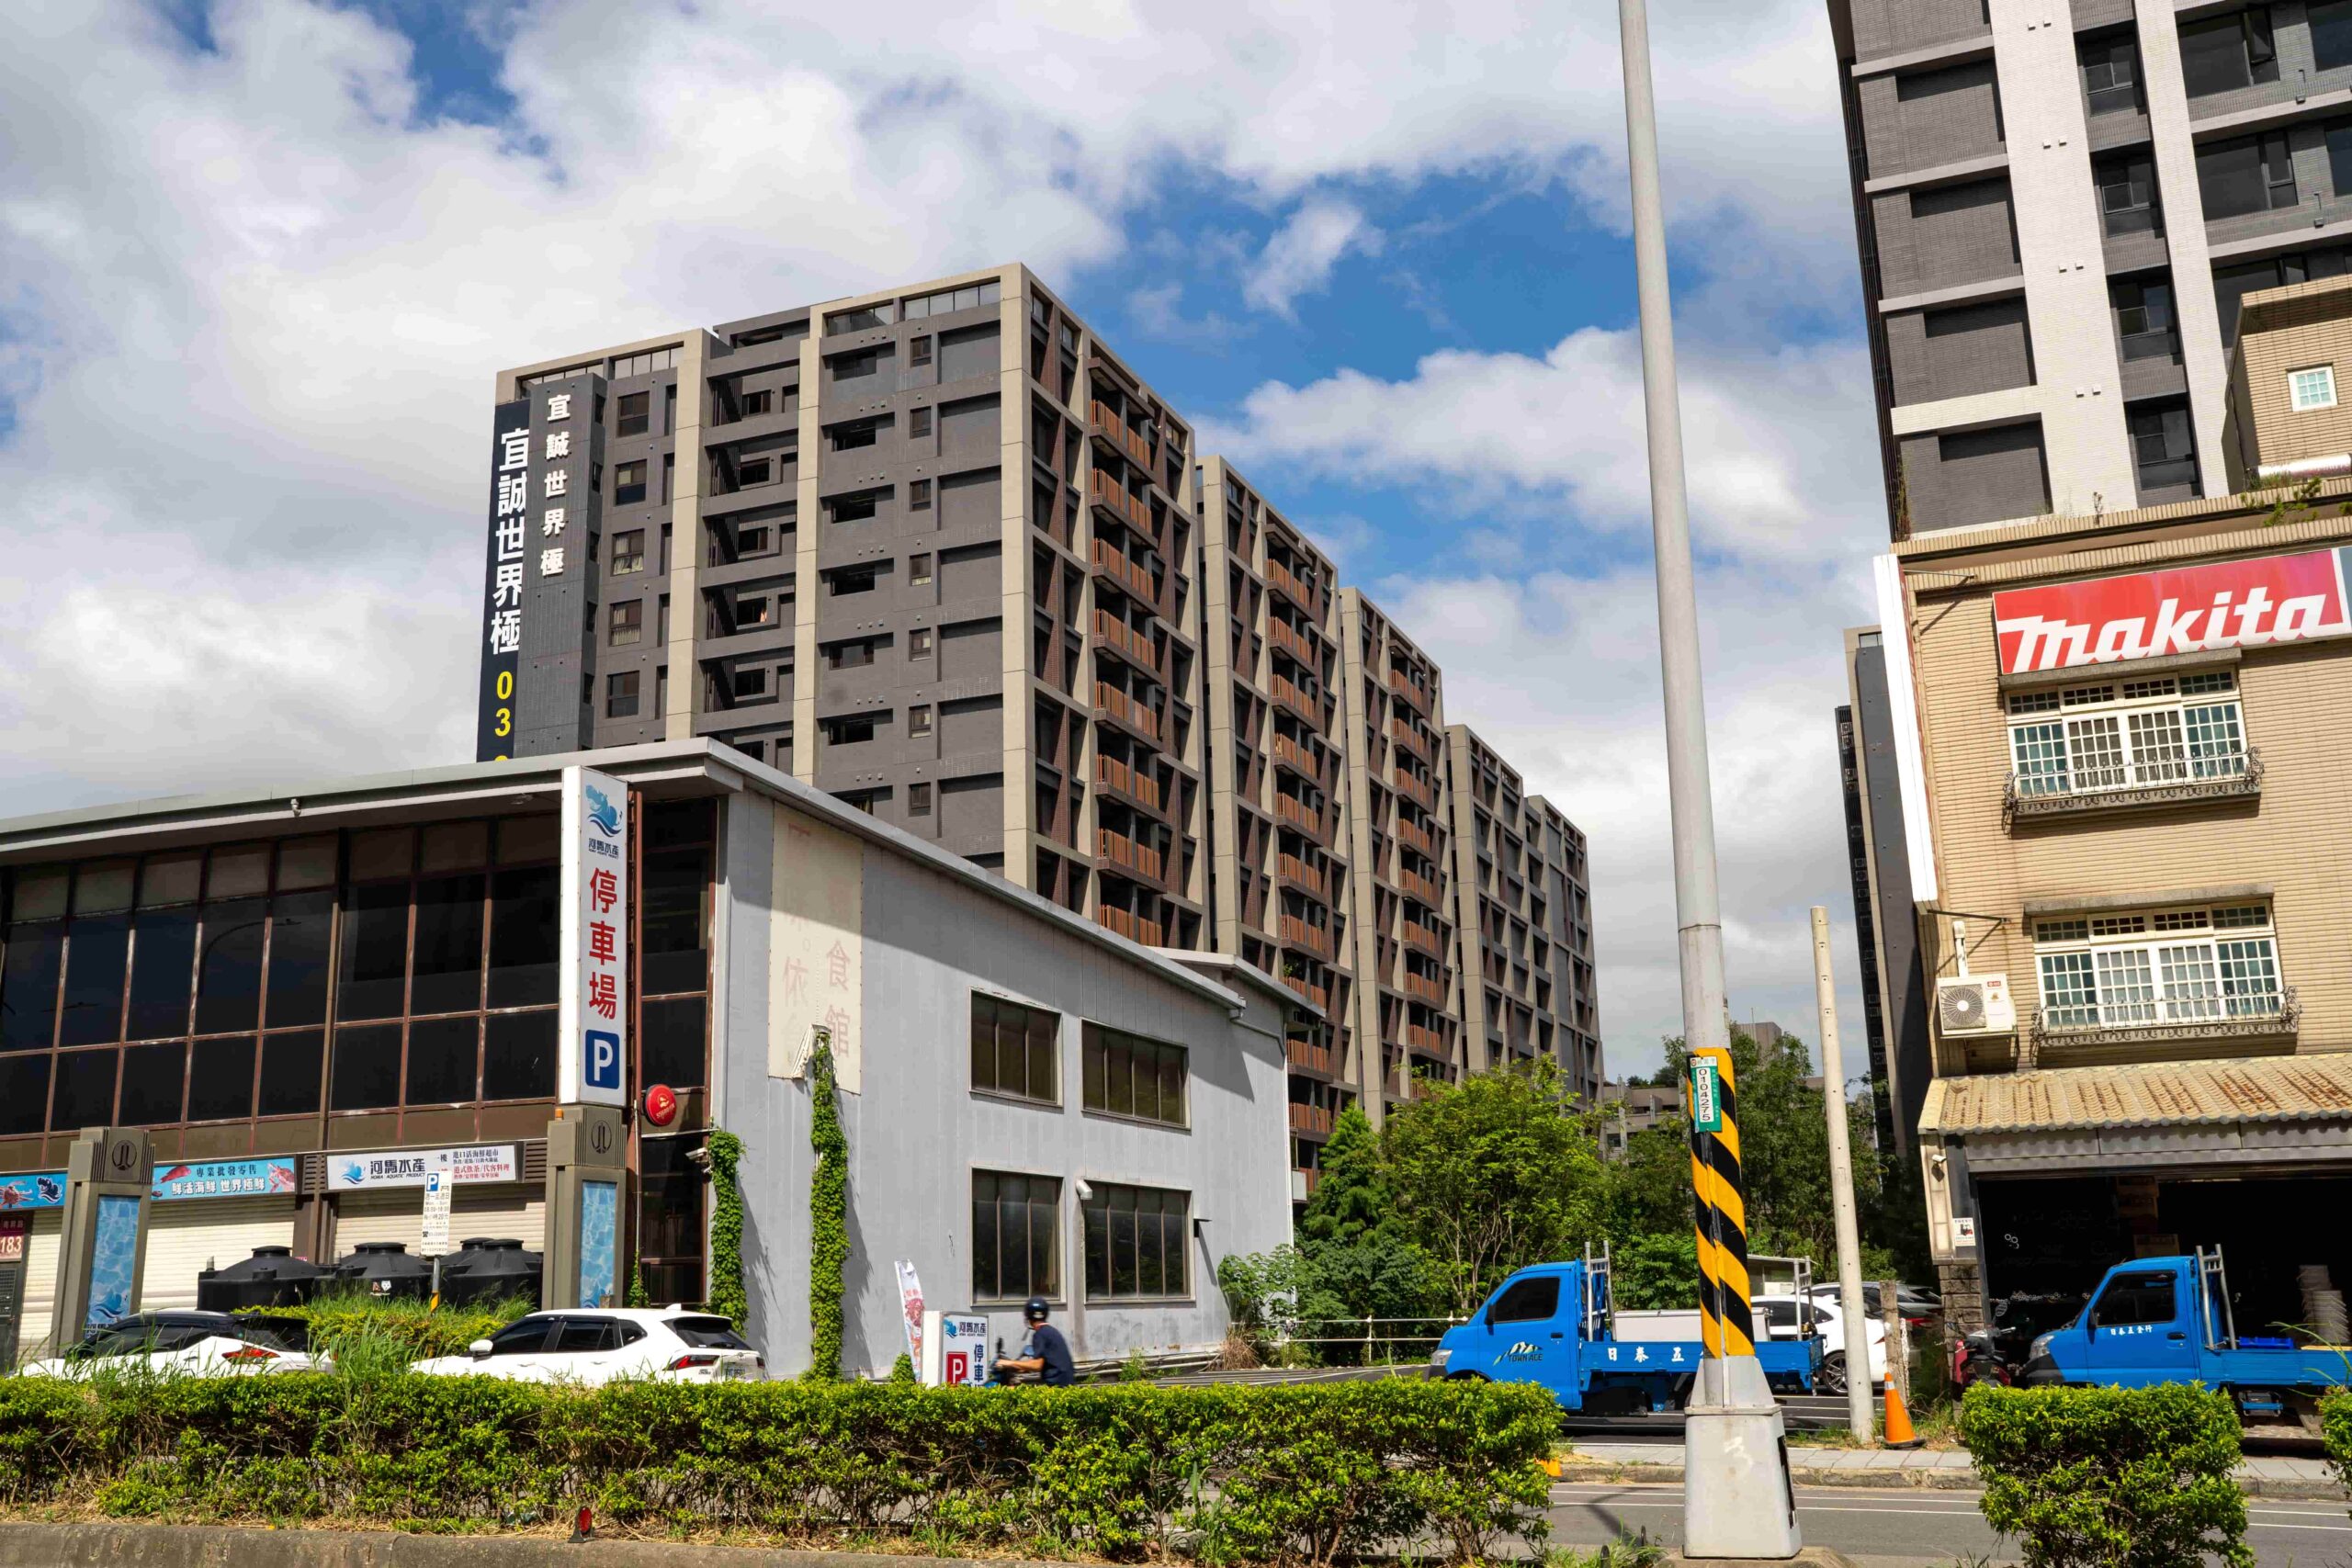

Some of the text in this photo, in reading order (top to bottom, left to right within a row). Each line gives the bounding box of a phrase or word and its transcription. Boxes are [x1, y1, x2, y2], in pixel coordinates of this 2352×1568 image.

[540, 392, 571, 577] 宜誠世界極
[491, 427, 529, 655] 宜誠世界極
[1997, 587, 2344, 673] makita
[589, 867, 617, 1021] 停車場
[594, 1038, 614, 1081] P
[1699, 1068, 1711, 1121] 0104275
[172, 1177, 266, 1195] 鮮活海鮮 世界極鮮
[197, 1164, 257, 1178] 專業批發零售
[370, 1158, 426, 1175] 河馬水產
[427, 1175, 438, 1190] P
[952, 1359, 964, 1384] P
[974, 1344, 984, 1386] 停車
[1608, 1346, 1705, 1363] 日泰五
